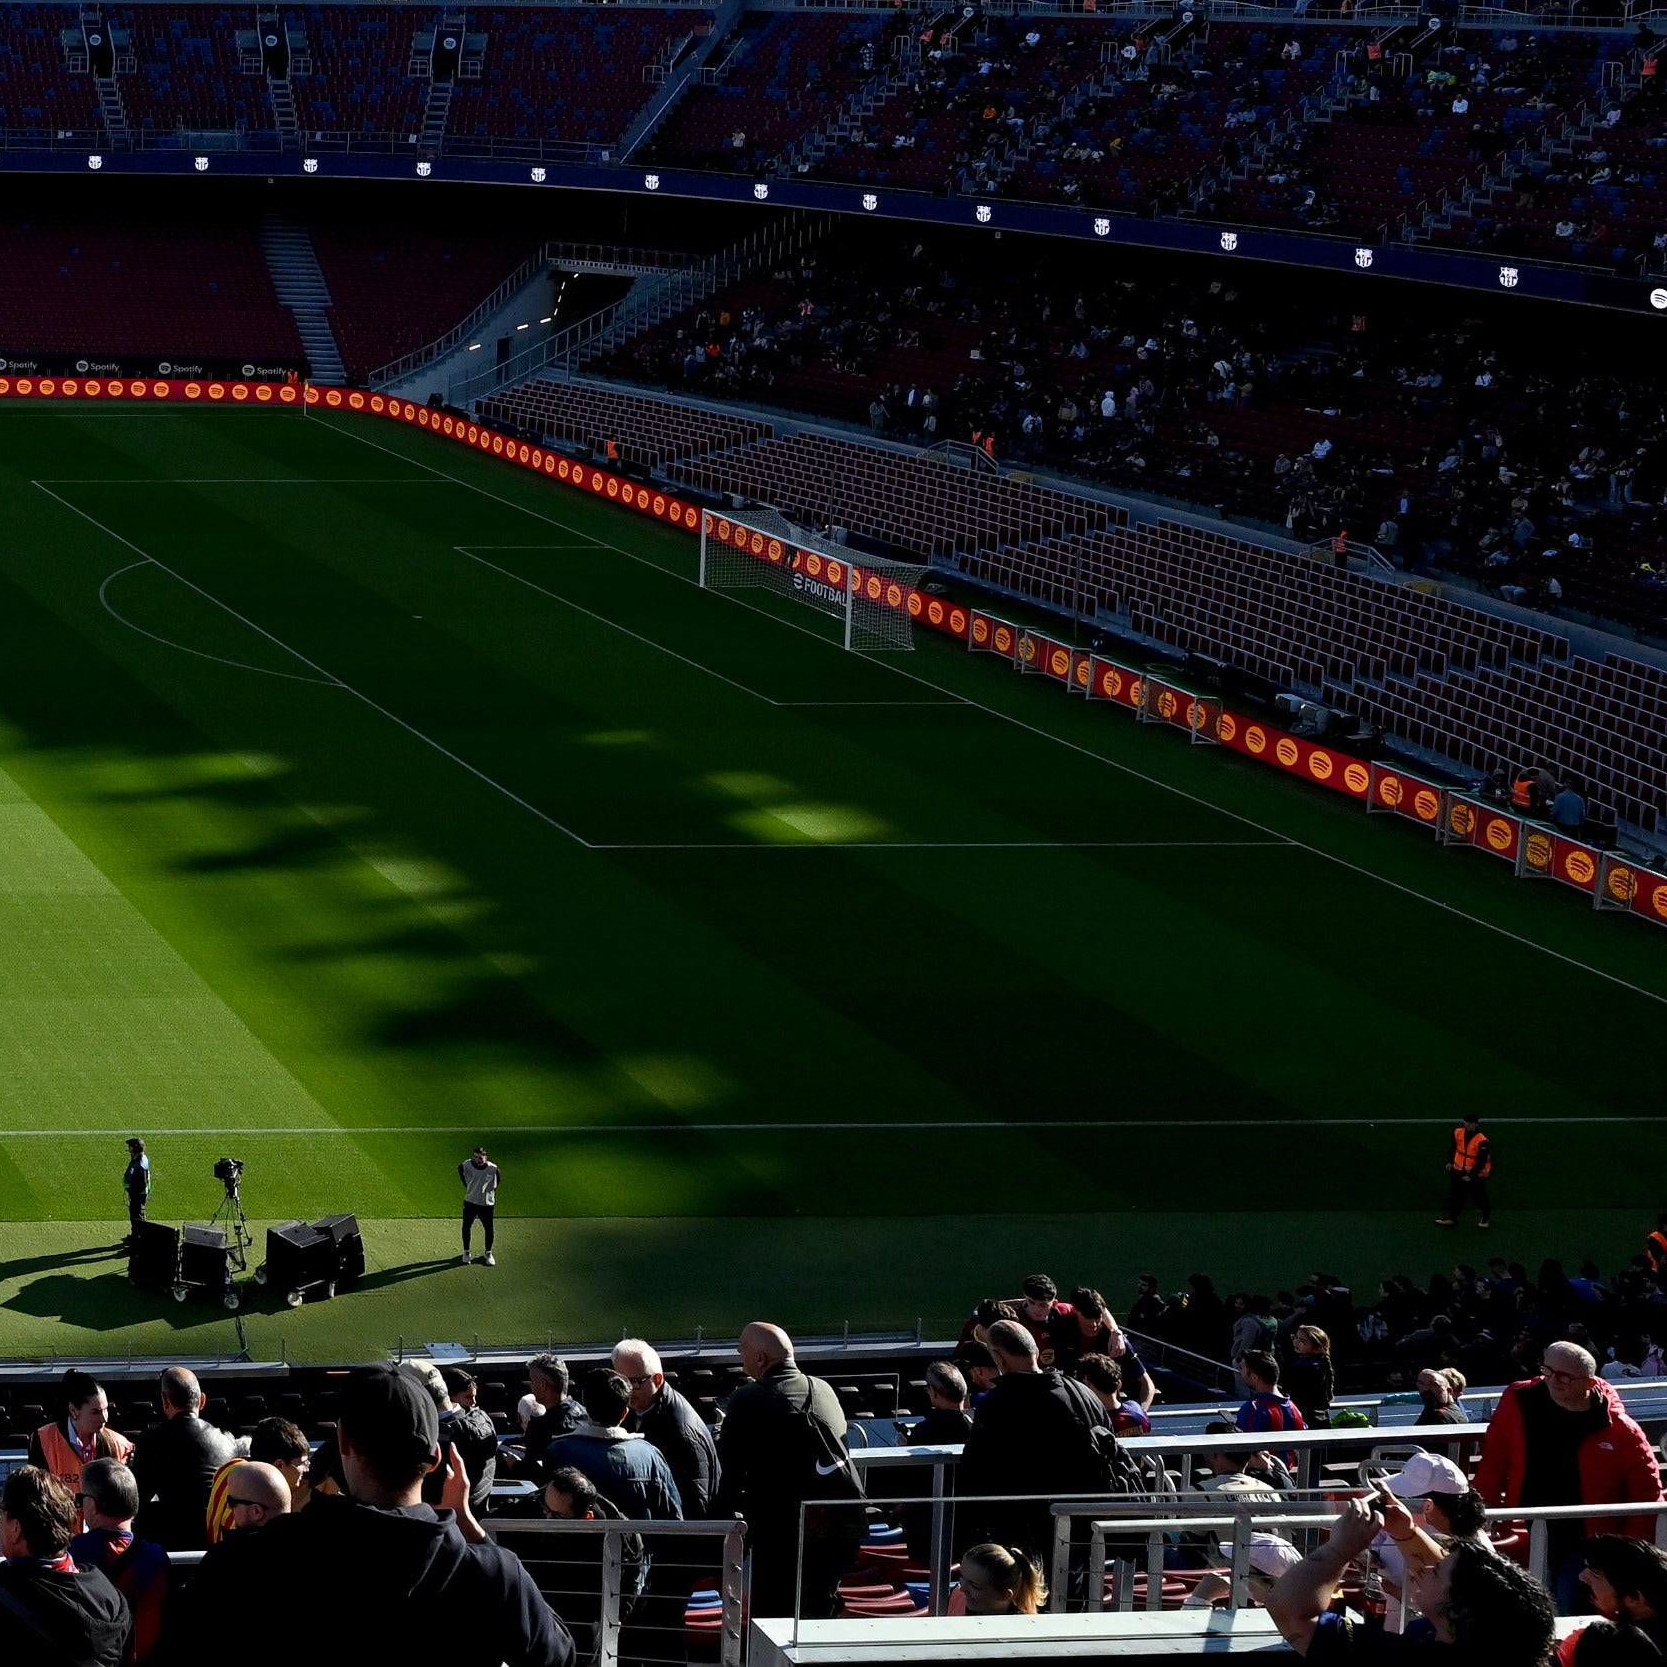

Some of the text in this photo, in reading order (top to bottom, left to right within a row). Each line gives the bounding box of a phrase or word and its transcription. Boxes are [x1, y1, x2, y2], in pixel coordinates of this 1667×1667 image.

[9, 361, 37, 369] Spotify
[91, 363, 120, 371] Spotify
[173, 365, 202, 374] Spotify
[257, 367, 286, 375] Spotify
